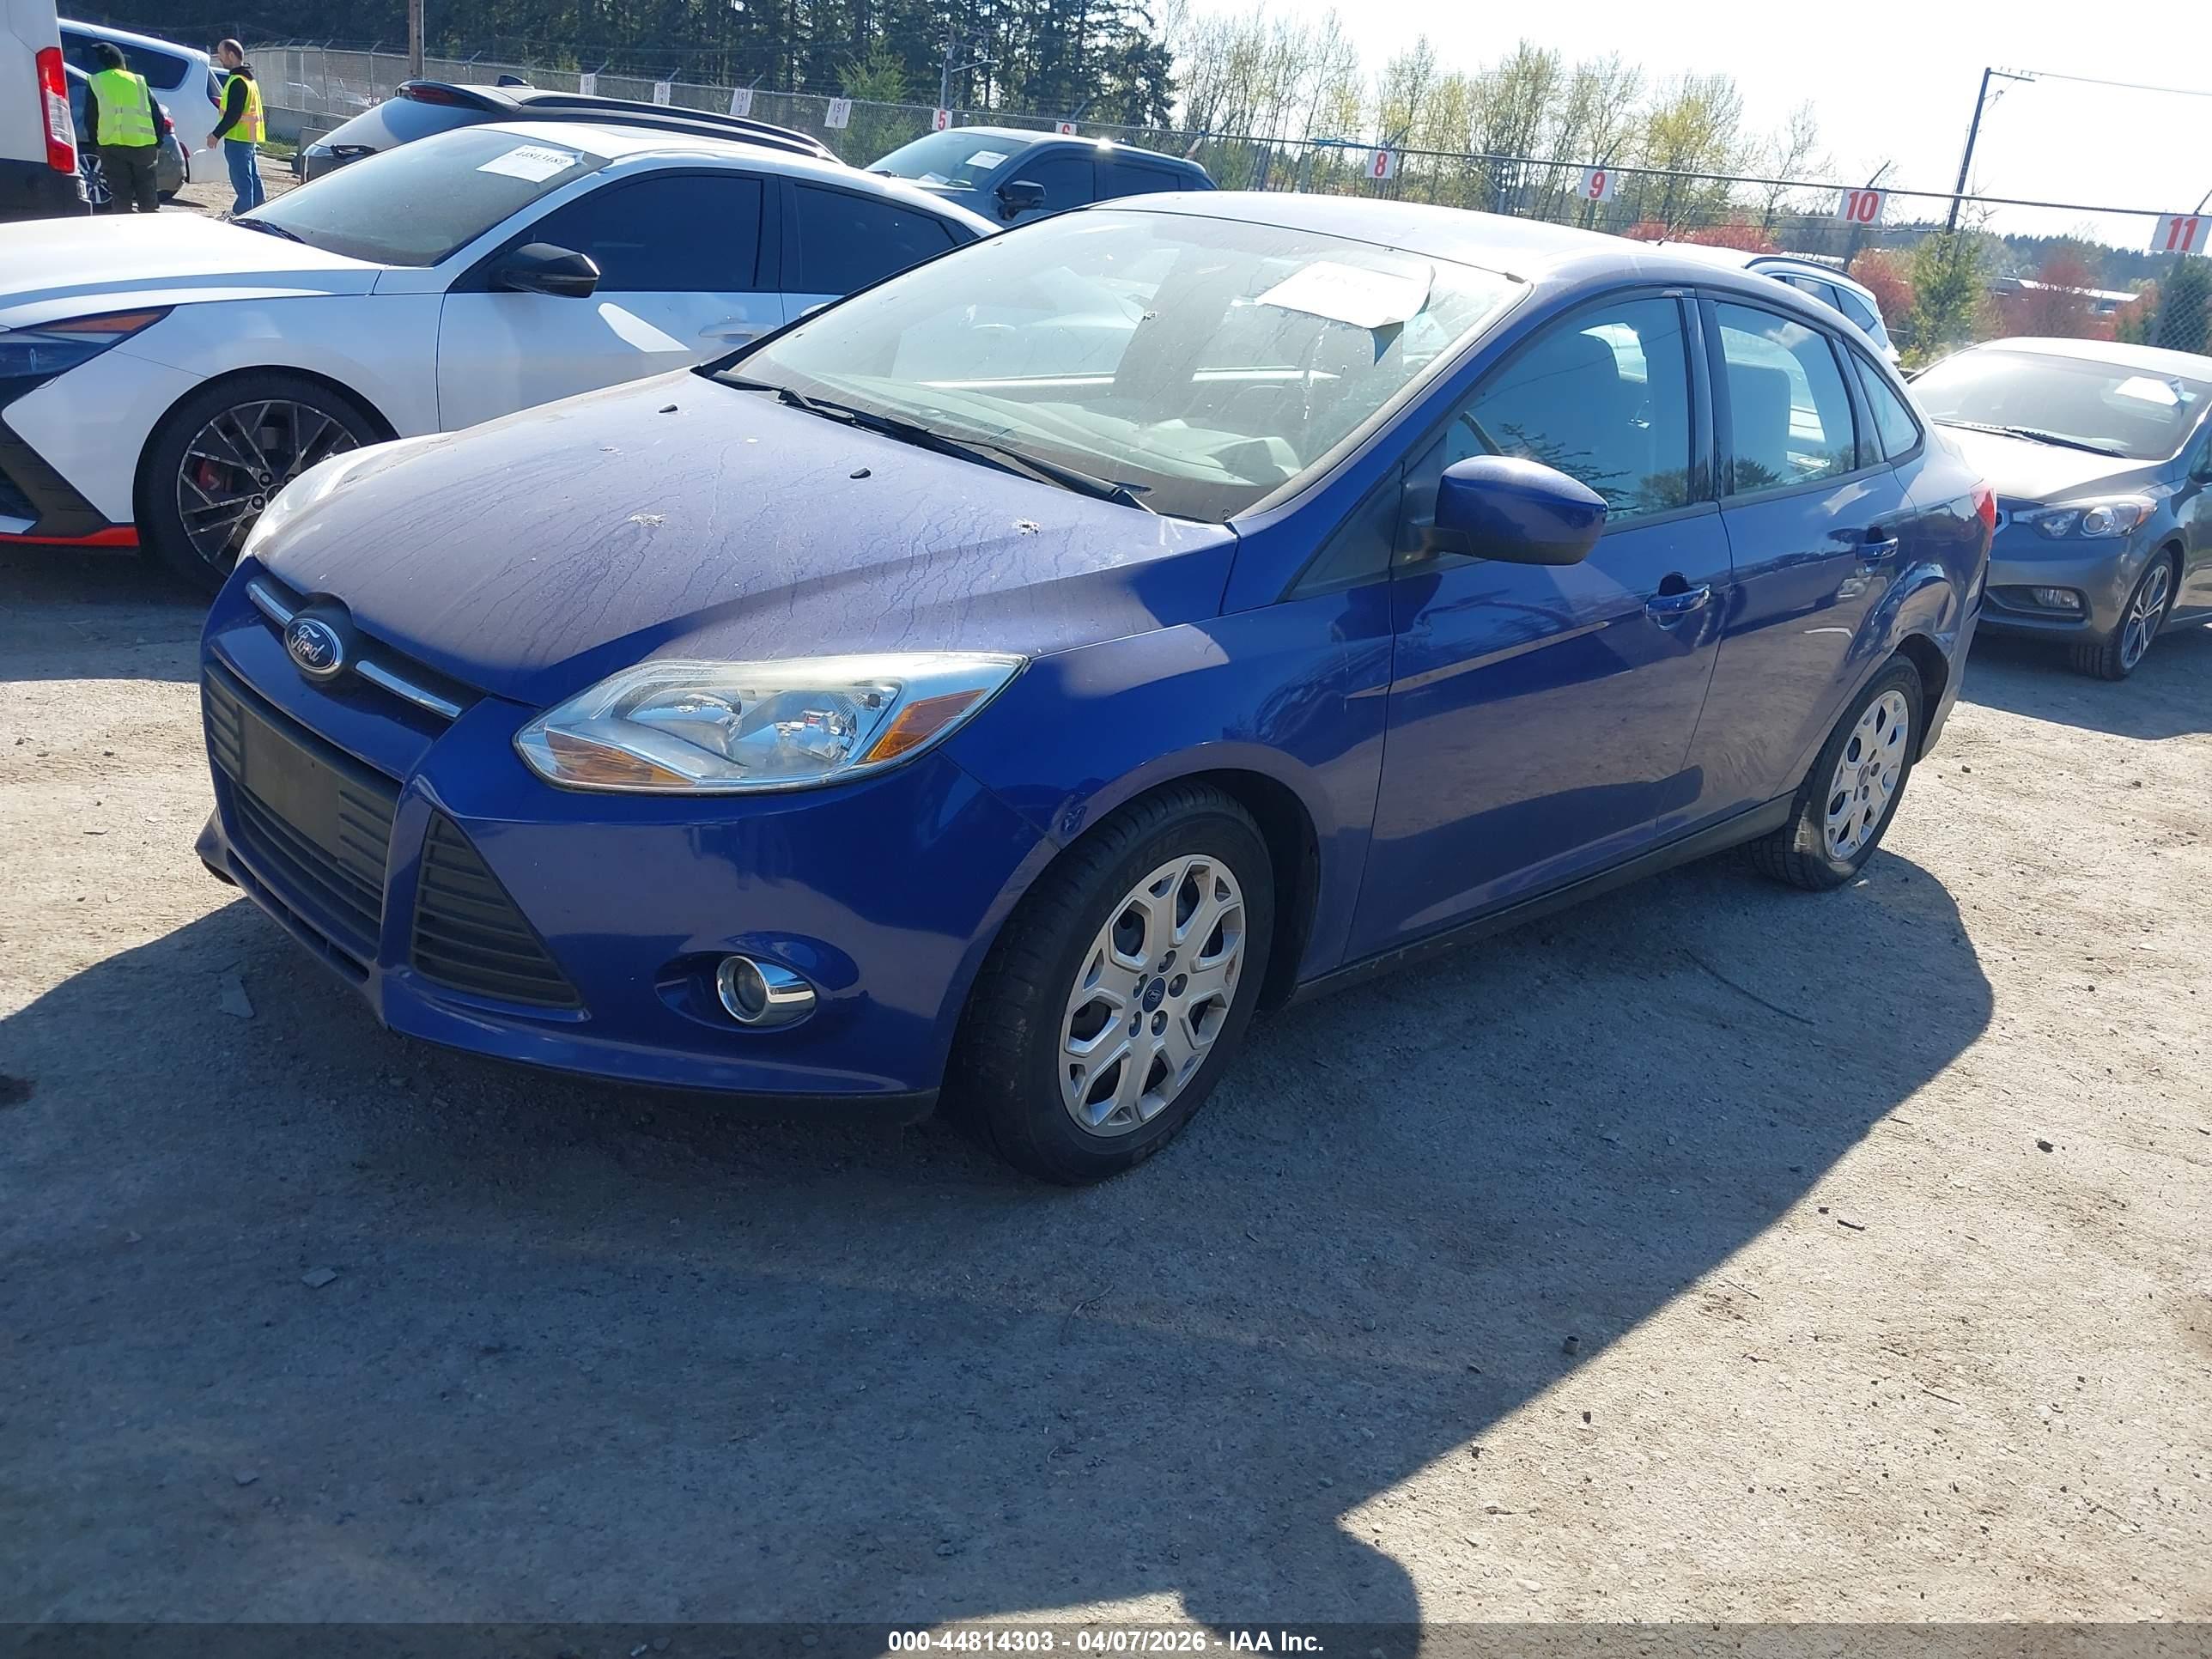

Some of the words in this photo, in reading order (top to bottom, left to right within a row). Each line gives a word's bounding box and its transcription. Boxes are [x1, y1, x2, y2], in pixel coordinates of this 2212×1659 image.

[938, 110, 947, 131] 5
[1374, 152, 1388, 178] 8
[1589, 171, 1606, 199] 9
[1845, 191, 1879, 222] 10
[2166, 217, 2199, 251] 11
[290, 624, 325, 662] Ford
